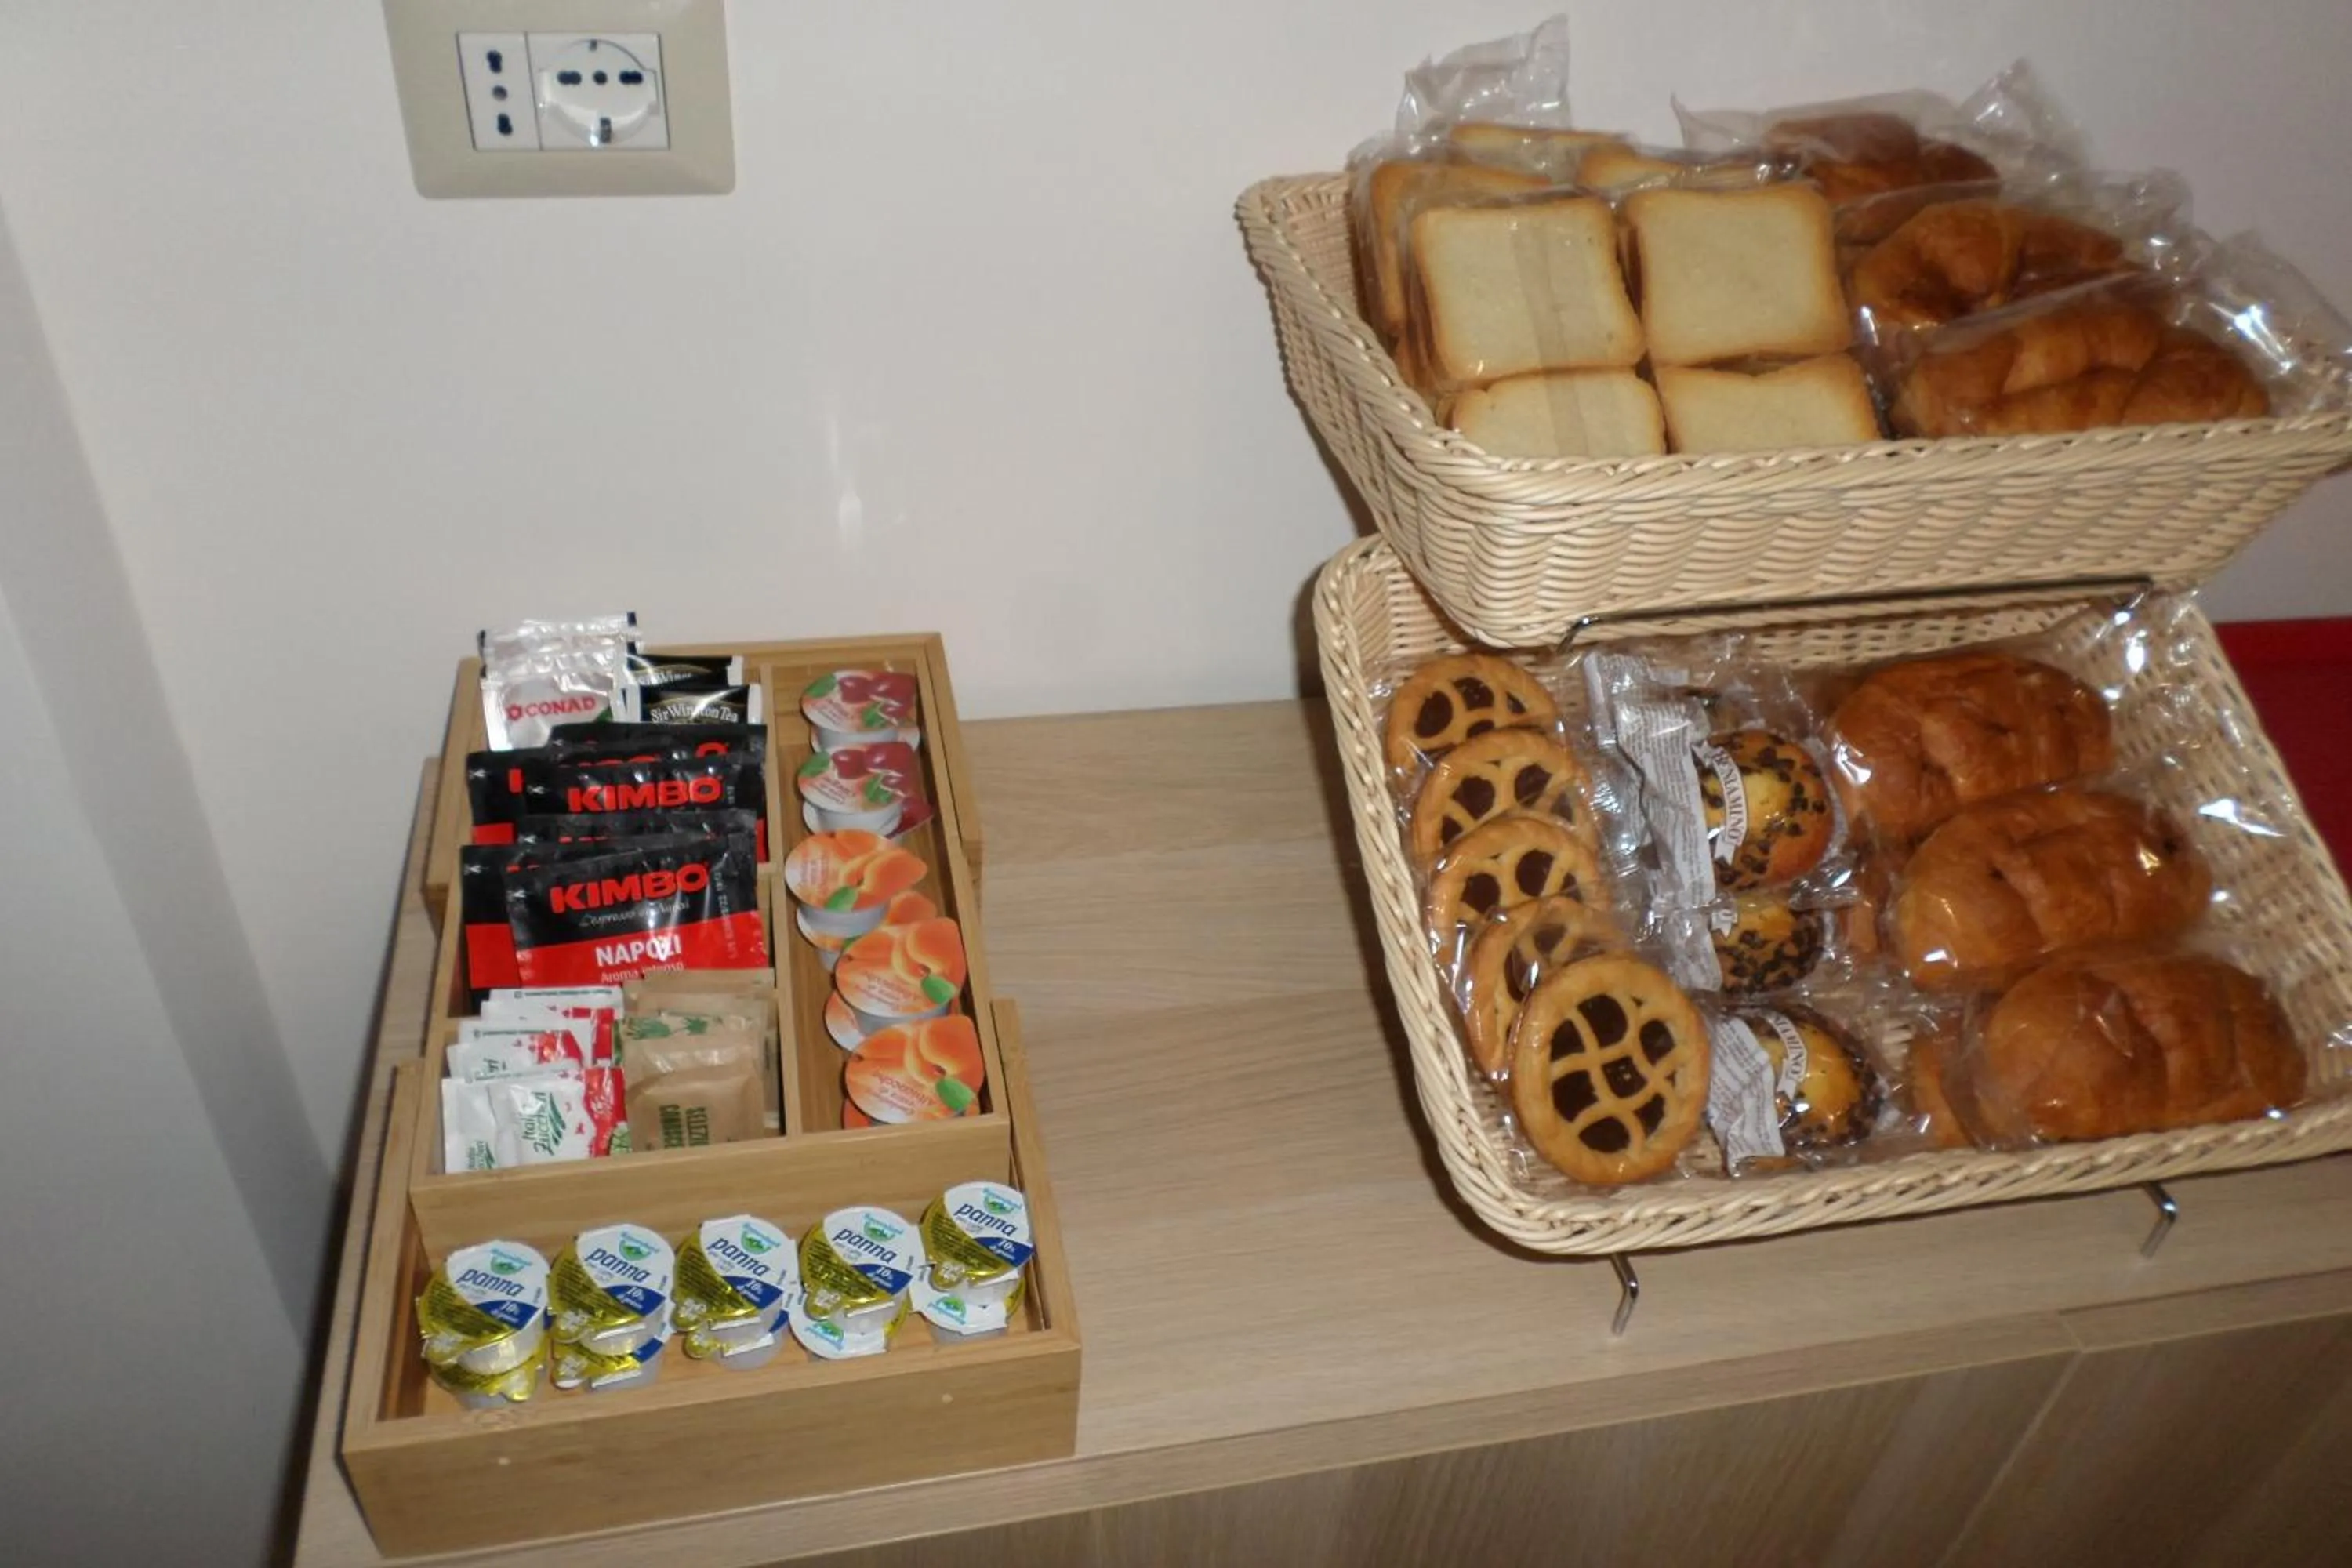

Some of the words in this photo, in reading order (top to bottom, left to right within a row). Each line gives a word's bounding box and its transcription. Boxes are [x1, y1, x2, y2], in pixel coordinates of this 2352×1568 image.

[524, 696, 596, 719] CONAD
[666, 703, 720, 720] Winton
[720, 706, 739, 722] Tea
[567, 777, 722, 813] KIMBO
[550, 863, 710, 914] KIMBO
[601, 967, 640, 983] Aroma
[953, 1203, 1018, 1236] panna
[706, 1237, 771, 1277] panna
[832, 1229, 898, 1265] panna
[584, 1247, 652, 1283] panna
[456, 1268, 525, 1298] panna
